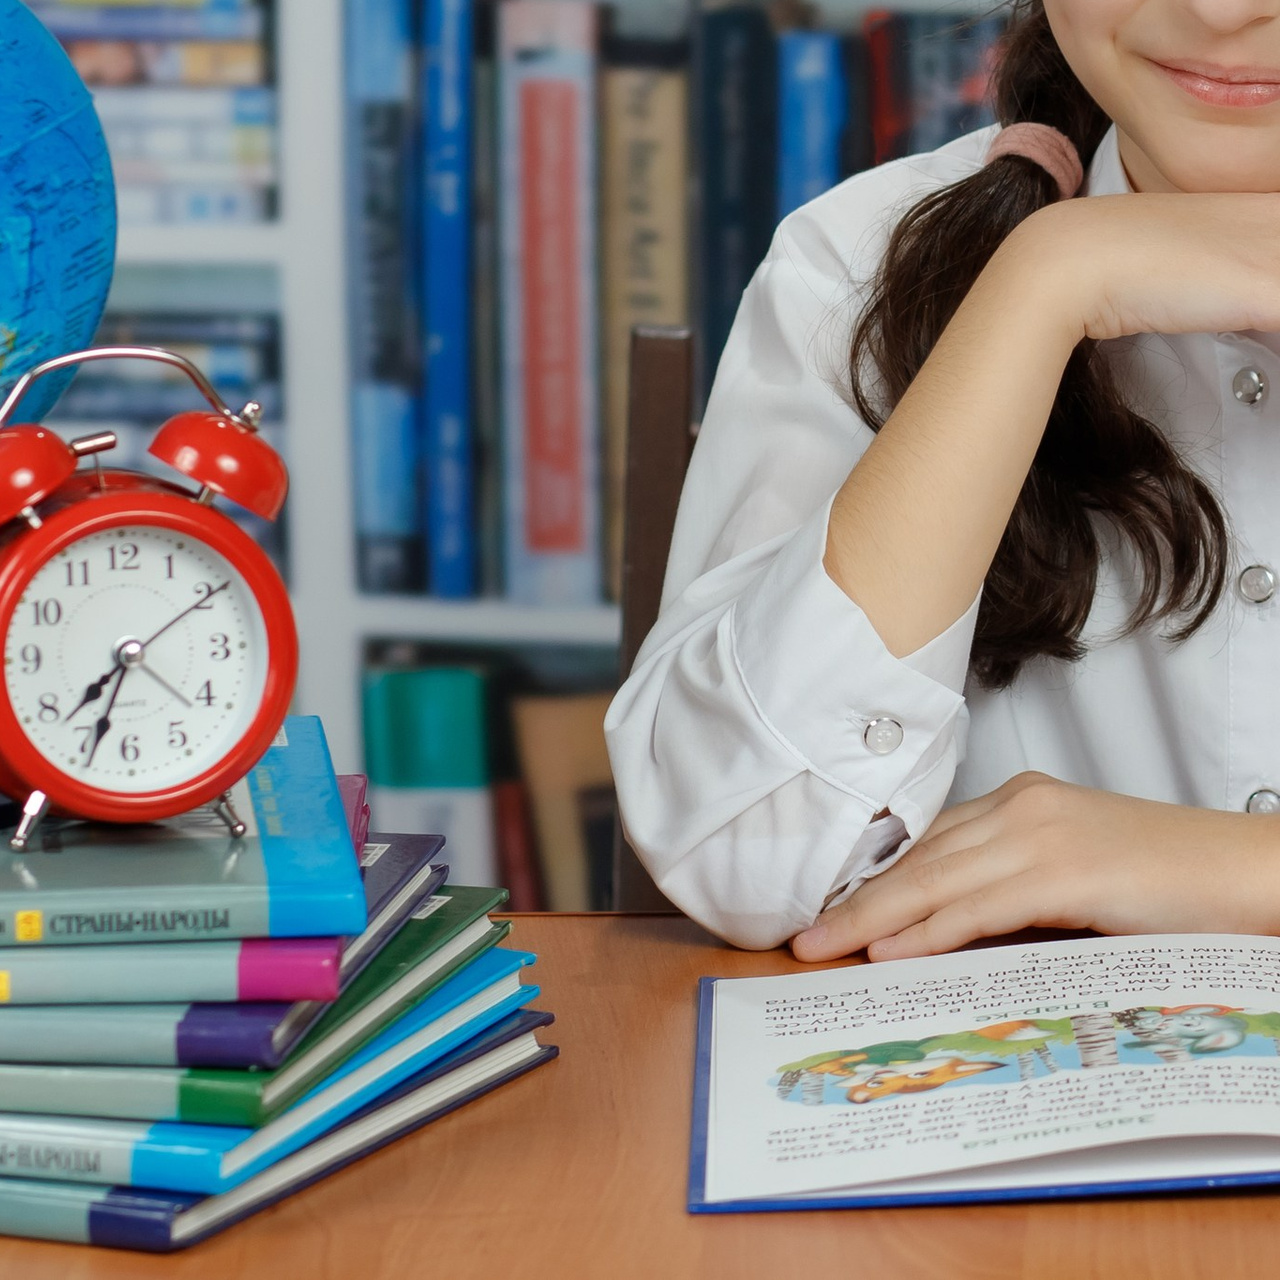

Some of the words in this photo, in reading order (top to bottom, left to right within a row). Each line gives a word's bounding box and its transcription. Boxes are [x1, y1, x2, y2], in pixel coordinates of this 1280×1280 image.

[107, 542, 140, 570] 12
[63, 559, 90, 587] 11
[164, 553, 175, 579] 1
[193, 582, 214, 609] 2
[31, 597, 62, 626] 10
[210, 633, 231, 660] 3
[20, 643, 42, 674] 9
[195, 679, 216, 707] 4
[38, 691, 60, 723] 8
[73, 725, 94, 754] 7
[168, 720, 188, 748] 5
[120, 733, 140, 761] 6
[1020, 947, 1184, 963] спря-та-лись.
[987, 959, 1104, 977] рас-крыл
[1102, 962, 1171, 971] Вдруг
[915, 976, 972, 986] е-го,
[994, 970, 1084, 984] по-шёл
[1051, 970, 1176, 984] слад-ку-ю
[891, 981, 978, 997] дождь.
[980, 981, 1046, 993] ва-ту.
[1062, 981, 1118, 990] о-ни
[1078, 985, 1171, 996] А-ли-са
[765, 988, 868, 1005] ре-бя-та
[860, 997, 876, 1005] У
[923, 987, 1052, 1008] ка-та-лись
[935, 990, 972, 999] Им
[973, 994, 1066, 1010] пош-ли
[765, 1001, 844, 1013] Па-ши
[855, 997, 929, 1012] бы-ло
[886, 1007, 914, 1015] на
[974, 1003, 1080, 1022] пар-ке
[1092, 1001, 1109, 1009] В
[764, 1008, 849, 1021] о-чень
[764, 1013, 876, 1029] ка-ру-се-
[876, 1011, 937, 1024] парк
[764, 1022, 865, 1038] ат-трак-
[1039, 1069, 1144, 1088] быс-тро
[923, 1099, 1006, 1115] Ког-да
